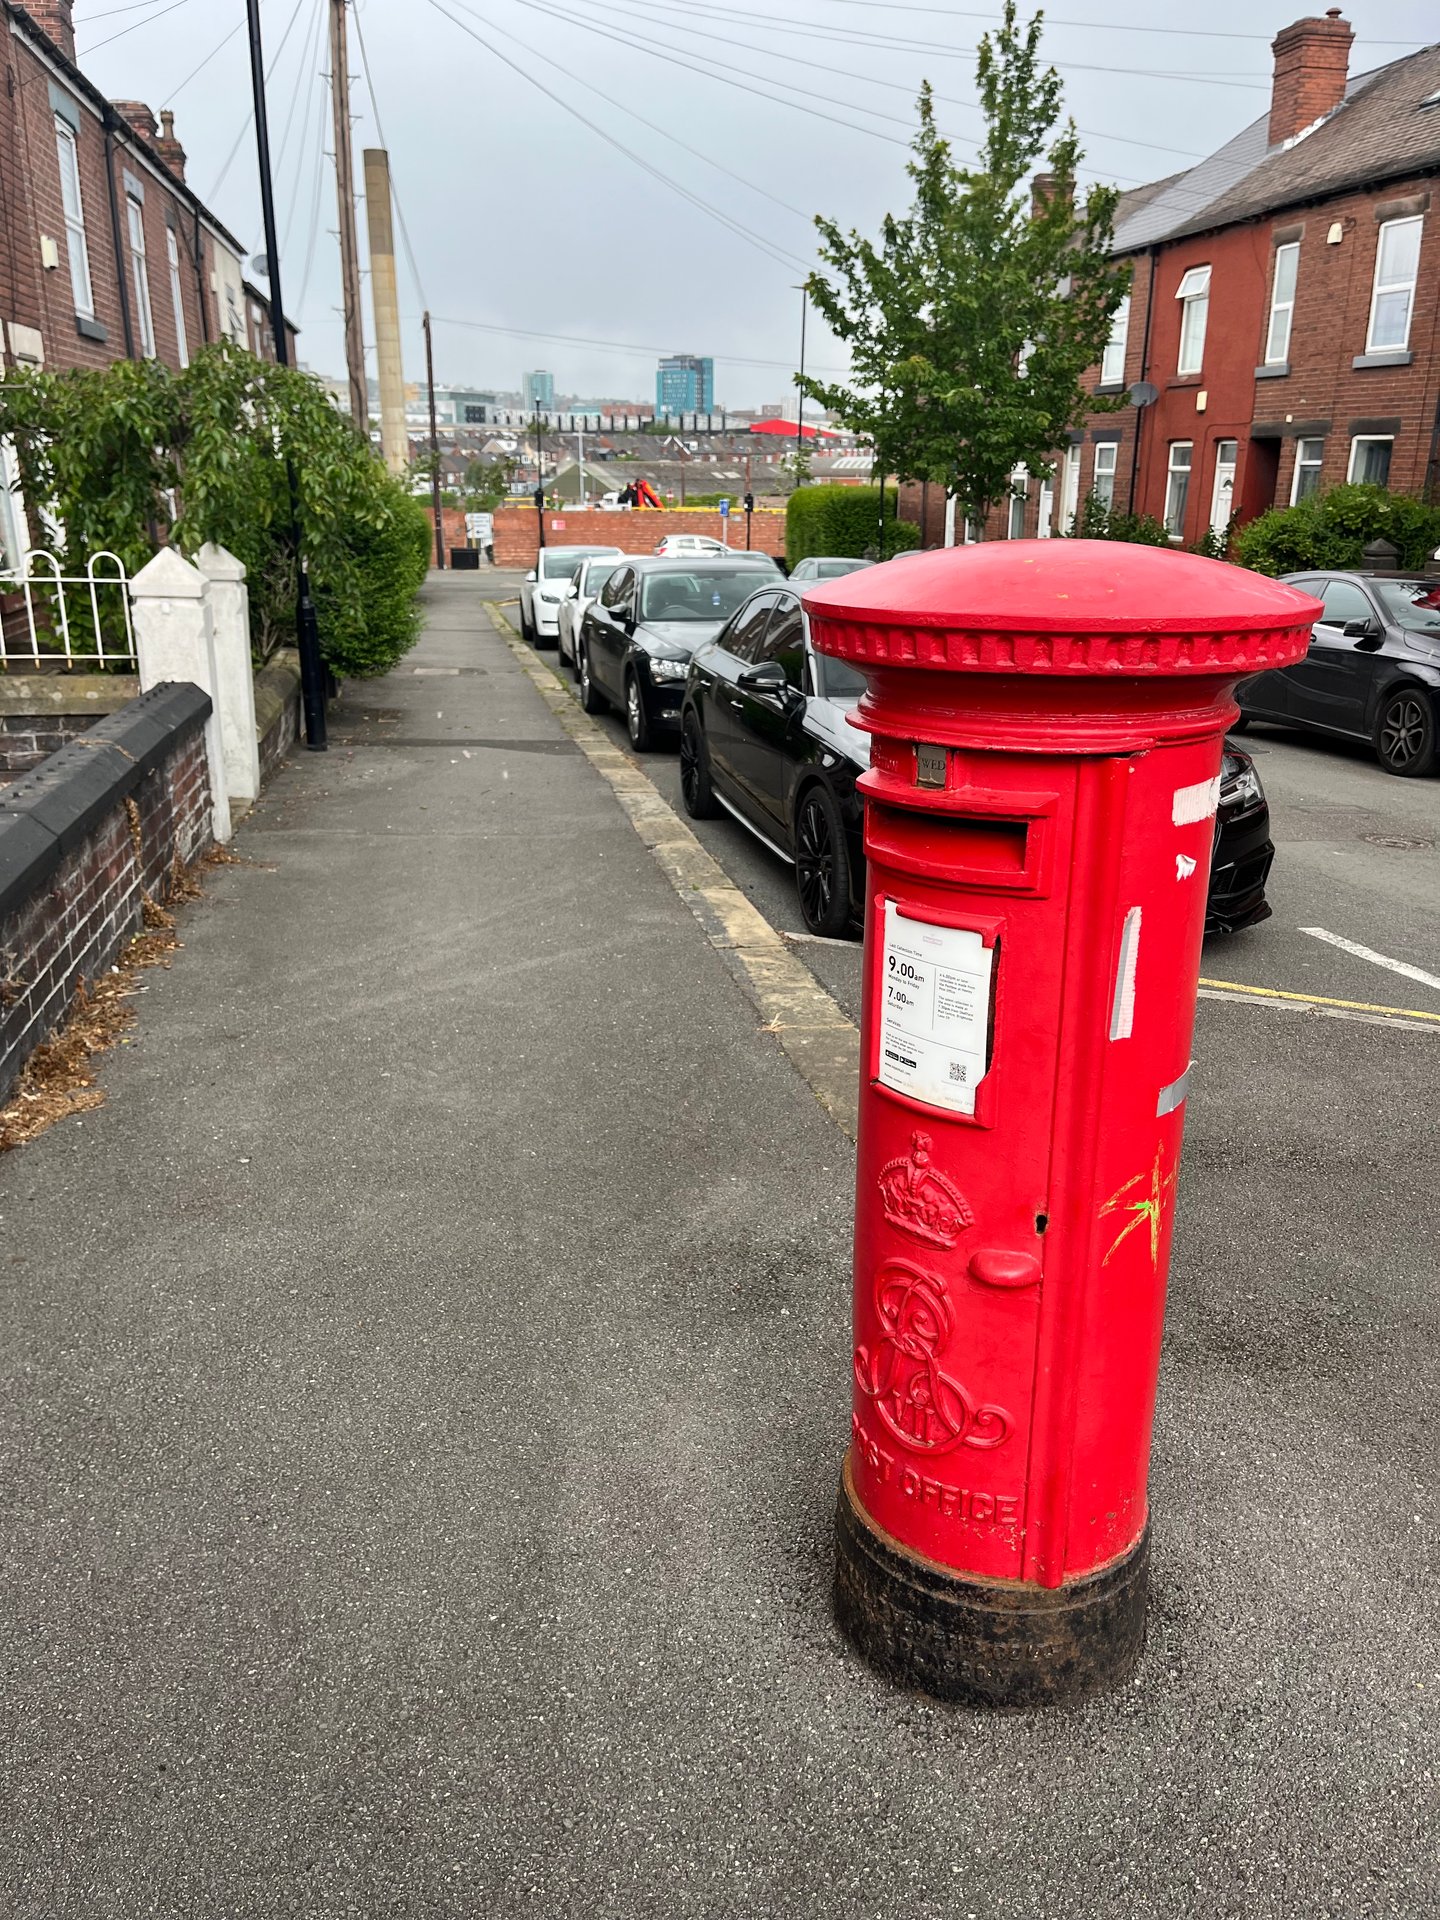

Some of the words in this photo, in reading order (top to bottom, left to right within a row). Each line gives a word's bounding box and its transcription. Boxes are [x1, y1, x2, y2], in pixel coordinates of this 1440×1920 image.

[921, 758, 945, 771] WED
[888, 955, 925, 982] 9.00am
[888, 974, 902, 984] Monday
[907, 981, 920, 989] Friday
[888, 986, 915, 1006] 7.00am
[887, 1000, 903, 1011] Saturday
[900, 1464, 1020, 1526] OFFICE
